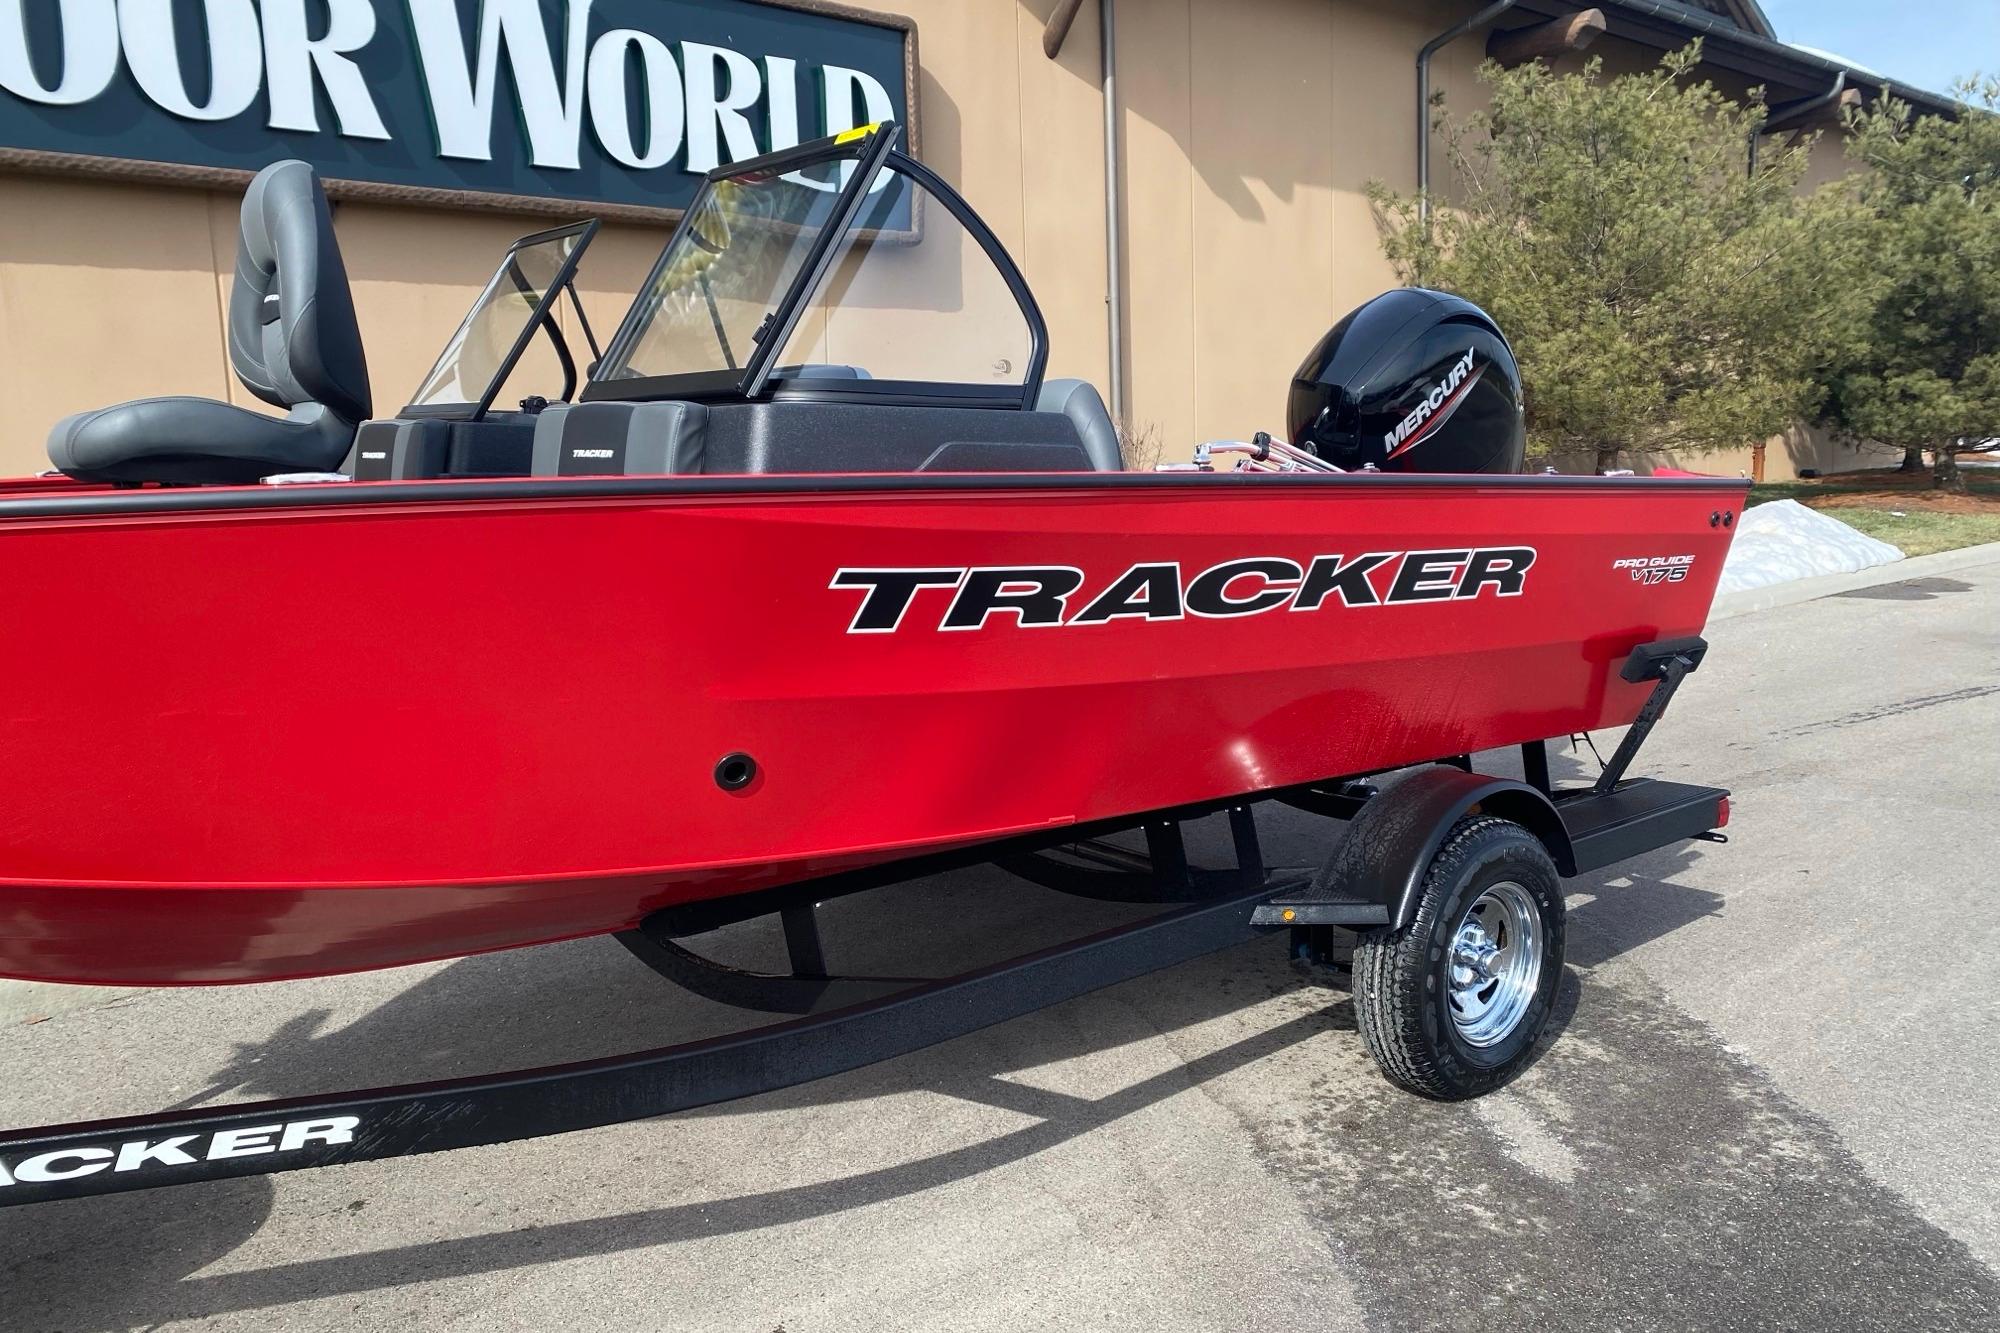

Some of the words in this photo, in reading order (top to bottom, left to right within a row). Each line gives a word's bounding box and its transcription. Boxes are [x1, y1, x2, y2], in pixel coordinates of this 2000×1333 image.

[408, 0, 897, 194] WORLD
[1385, 346, 1475, 453] MERCURY
[572, 449, 614, 458] TRACKER
[828, 546, 1538, 633] TRACKER
[1613, 558, 1649, 569] PRO
[1650, 554, 1696, 567] GUIDE
[0, 1116, 360, 1187] CKER
